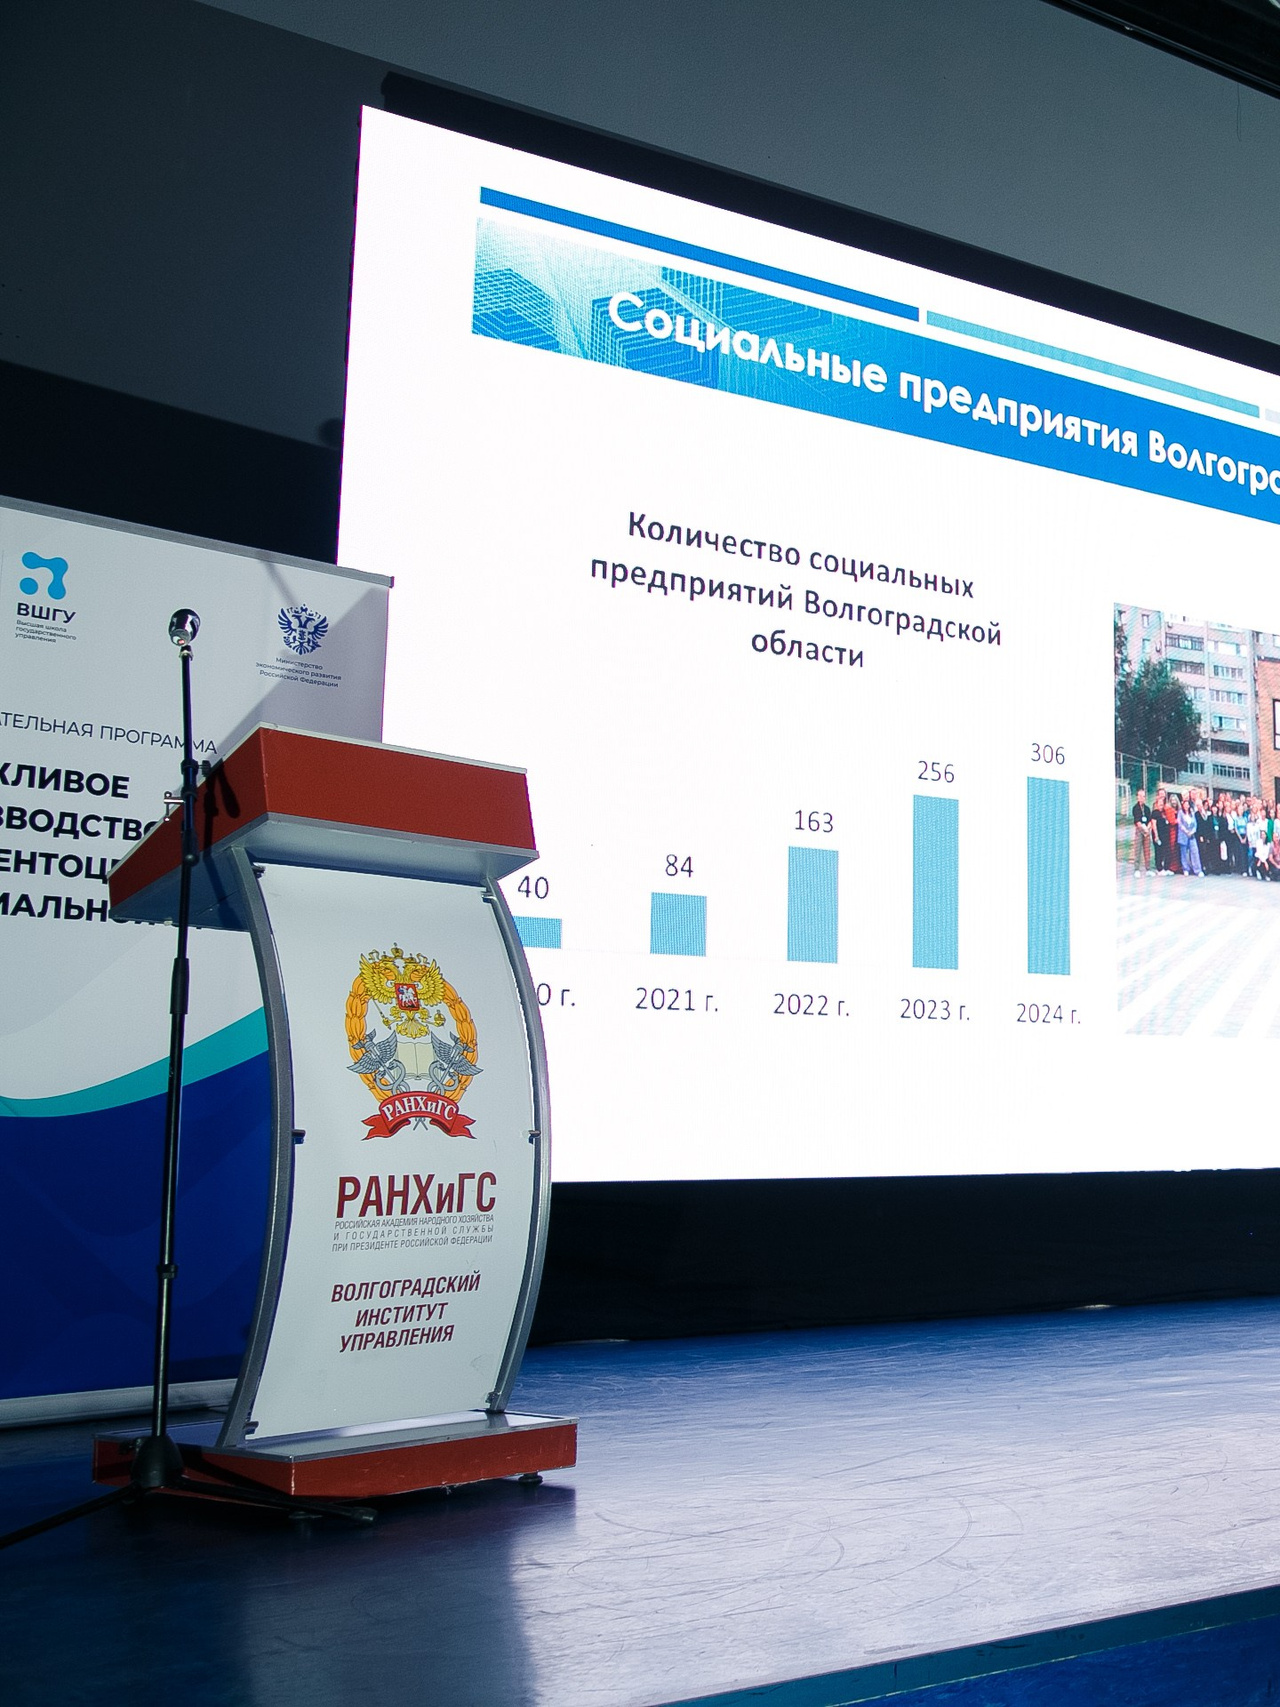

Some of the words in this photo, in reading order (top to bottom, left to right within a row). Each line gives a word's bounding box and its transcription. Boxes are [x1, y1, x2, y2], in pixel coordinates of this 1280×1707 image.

[607, 291, 888, 394] Социальные
[899, 371, 1138, 456] предприятия
[628, 511, 801, 567] Количество
[809, 551, 975, 599] социальных
[16, 602, 76, 623] ВШГУ
[591, 557, 794, 612] предприятий
[804, 589, 1002, 646] Волгоградской
[15, 626, 77, 640] государственного
[15, 633, 56, 643] управления
[16, 619, 44, 628] Высшая
[45, 625, 67, 633] школа
[751, 630, 864, 667] области
[275, 657, 323, 670] Министерство
[259, 669, 299, 681] Российской
[299, 677, 339, 688] Федерации
[310, 671, 342, 681] развития
[0, 711, 93, 737] ТЕЛЬНАЯ
[100, 725, 217, 755] ПРОГРАММА
[1031, 743, 1066, 766] 306
[917, 760, 955, 784] 256
[0, 806, 158, 841] ВОДСТВ
[794, 810, 834, 834] 163
[664, 854, 694, 878] 84
[517, 875, 550, 900] 40
[560, 988, 576, 1007] г.
[635, 986, 696, 1012] 2021
[705, 994, 719, 1012] г.
[773, 992, 829, 1016] 2022
[837, 1000, 850, 1017] г.
[900, 998, 951, 1020] 2023
[959, 1004, 970, 1021] г.
[1016, 1002, 1064, 1024] 2024
[1071, 1009, 1081, 1025] г.
[382, 1096, 457, 1121] РАНХиГС
[336, 1171, 497, 1219] РАНХиГС
[333, 1232, 340, 1241] И
[345, 1226, 447, 1240] ГОСУДАРСТВЕННОЙ
[452, 1224, 494, 1235] СЛУЖБЫ
[335, 1218, 381, 1230] РОССИЙСКАЯ
[381, 1217, 418, 1227] АКАДЕМИЯ
[418, 1215, 458, 1226] НАРОДНОГО
[458, 1213, 494, 1223] ХОЗЯЙСТВА
[332, 1243, 348, 1252] ПРИ
[350, 1240, 398, 1251] ПРЕЗИДЕНТЕ
[400, 1237, 449, 1248] РОССИЙСКОЙ
[450, 1234, 493, 1245] ФЕДЕРАЦИИ
[331, 1270, 481, 1303] ВОЛГОГРАДСКИЙ
[355, 1302, 449, 1328] ИНСТИТУТ
[339, 1324, 455, 1353] УПРАВЛЕНИЯ
